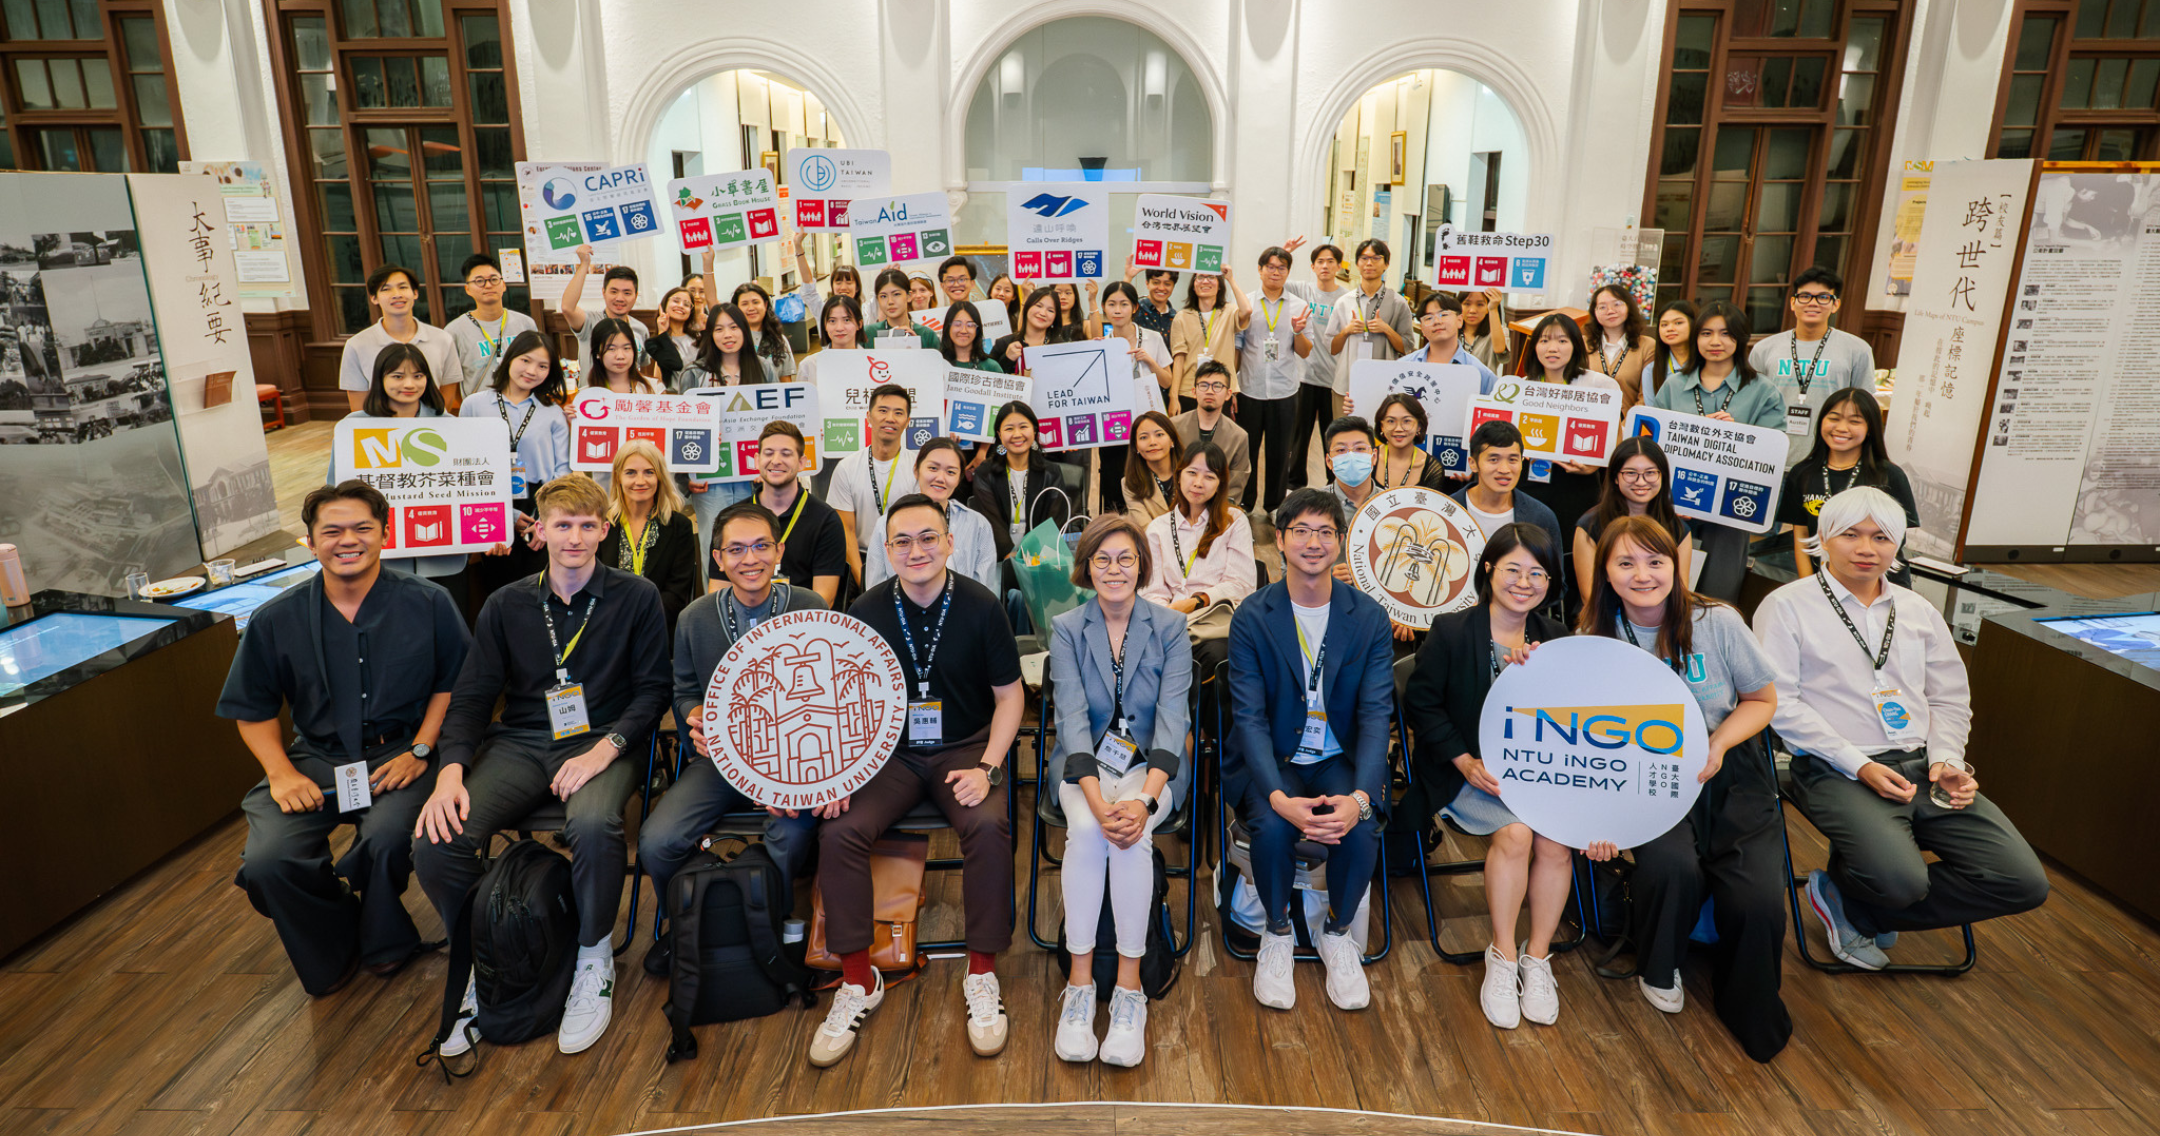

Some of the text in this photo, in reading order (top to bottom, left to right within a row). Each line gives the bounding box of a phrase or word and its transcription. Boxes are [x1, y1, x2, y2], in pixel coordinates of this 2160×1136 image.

[1142, 207, 1214, 222] World Vision
[1505, 235, 1550, 249] Step30
[1949, 196, 1994, 311] 跨世代
[188, 201, 232, 344] 大事紀要
[1925, 310, 1939, 319] Maps
[1946, 314, 1961, 322] NTU
[1777, 358, 1830, 377] NTU
[947, 384, 1024, 400] Jane Goodall Institute
[1047, 389, 1074, 399] LEAD
[1524, 385, 1612, 405] 台灣好鄰居協會
[1048, 395, 1111, 409] FOR TAIWAN
[1522, 398, 1589, 413] Good Neighbors
[827, 421, 832, 429] 3
[1523, 415, 1528, 424] 2
[1570, 420, 1576, 429] 4
[582, 429, 587, 437] 4
[630, 430, 635, 438] 5
[676, 431, 683, 439] 17
[1668, 420, 1757, 445] 台灣數位外交協會
[1436, 437, 1442, 445] 17
[1667, 431, 1737, 454] TAIWAN DIGITAL
[453, 457, 490, 466] 財團法人
[1664, 443, 1776, 475] DIPLOMACY ASSOCIATION
[356, 470, 495, 490] 基督教芥菜種會
[1677, 470, 1685, 480] 16
[1729, 481, 1737, 491] 17
[429, 490, 452, 498] Seed
[457, 489, 496, 498] Mission
[408, 509, 415, 519] 4
[462, 506, 473, 516] 10
[1353, 543, 1417, 624] National Taiwan
[705, 611, 905, 722] OFFICE OF INTERNATIONAL AFFAIRS
[707, 704, 905, 807] NATIONAL TAIWAN UNIVERSITY
[1503, 747, 1627, 772] NTU iNGO
[1501, 767, 1628, 792] ACADEMY
